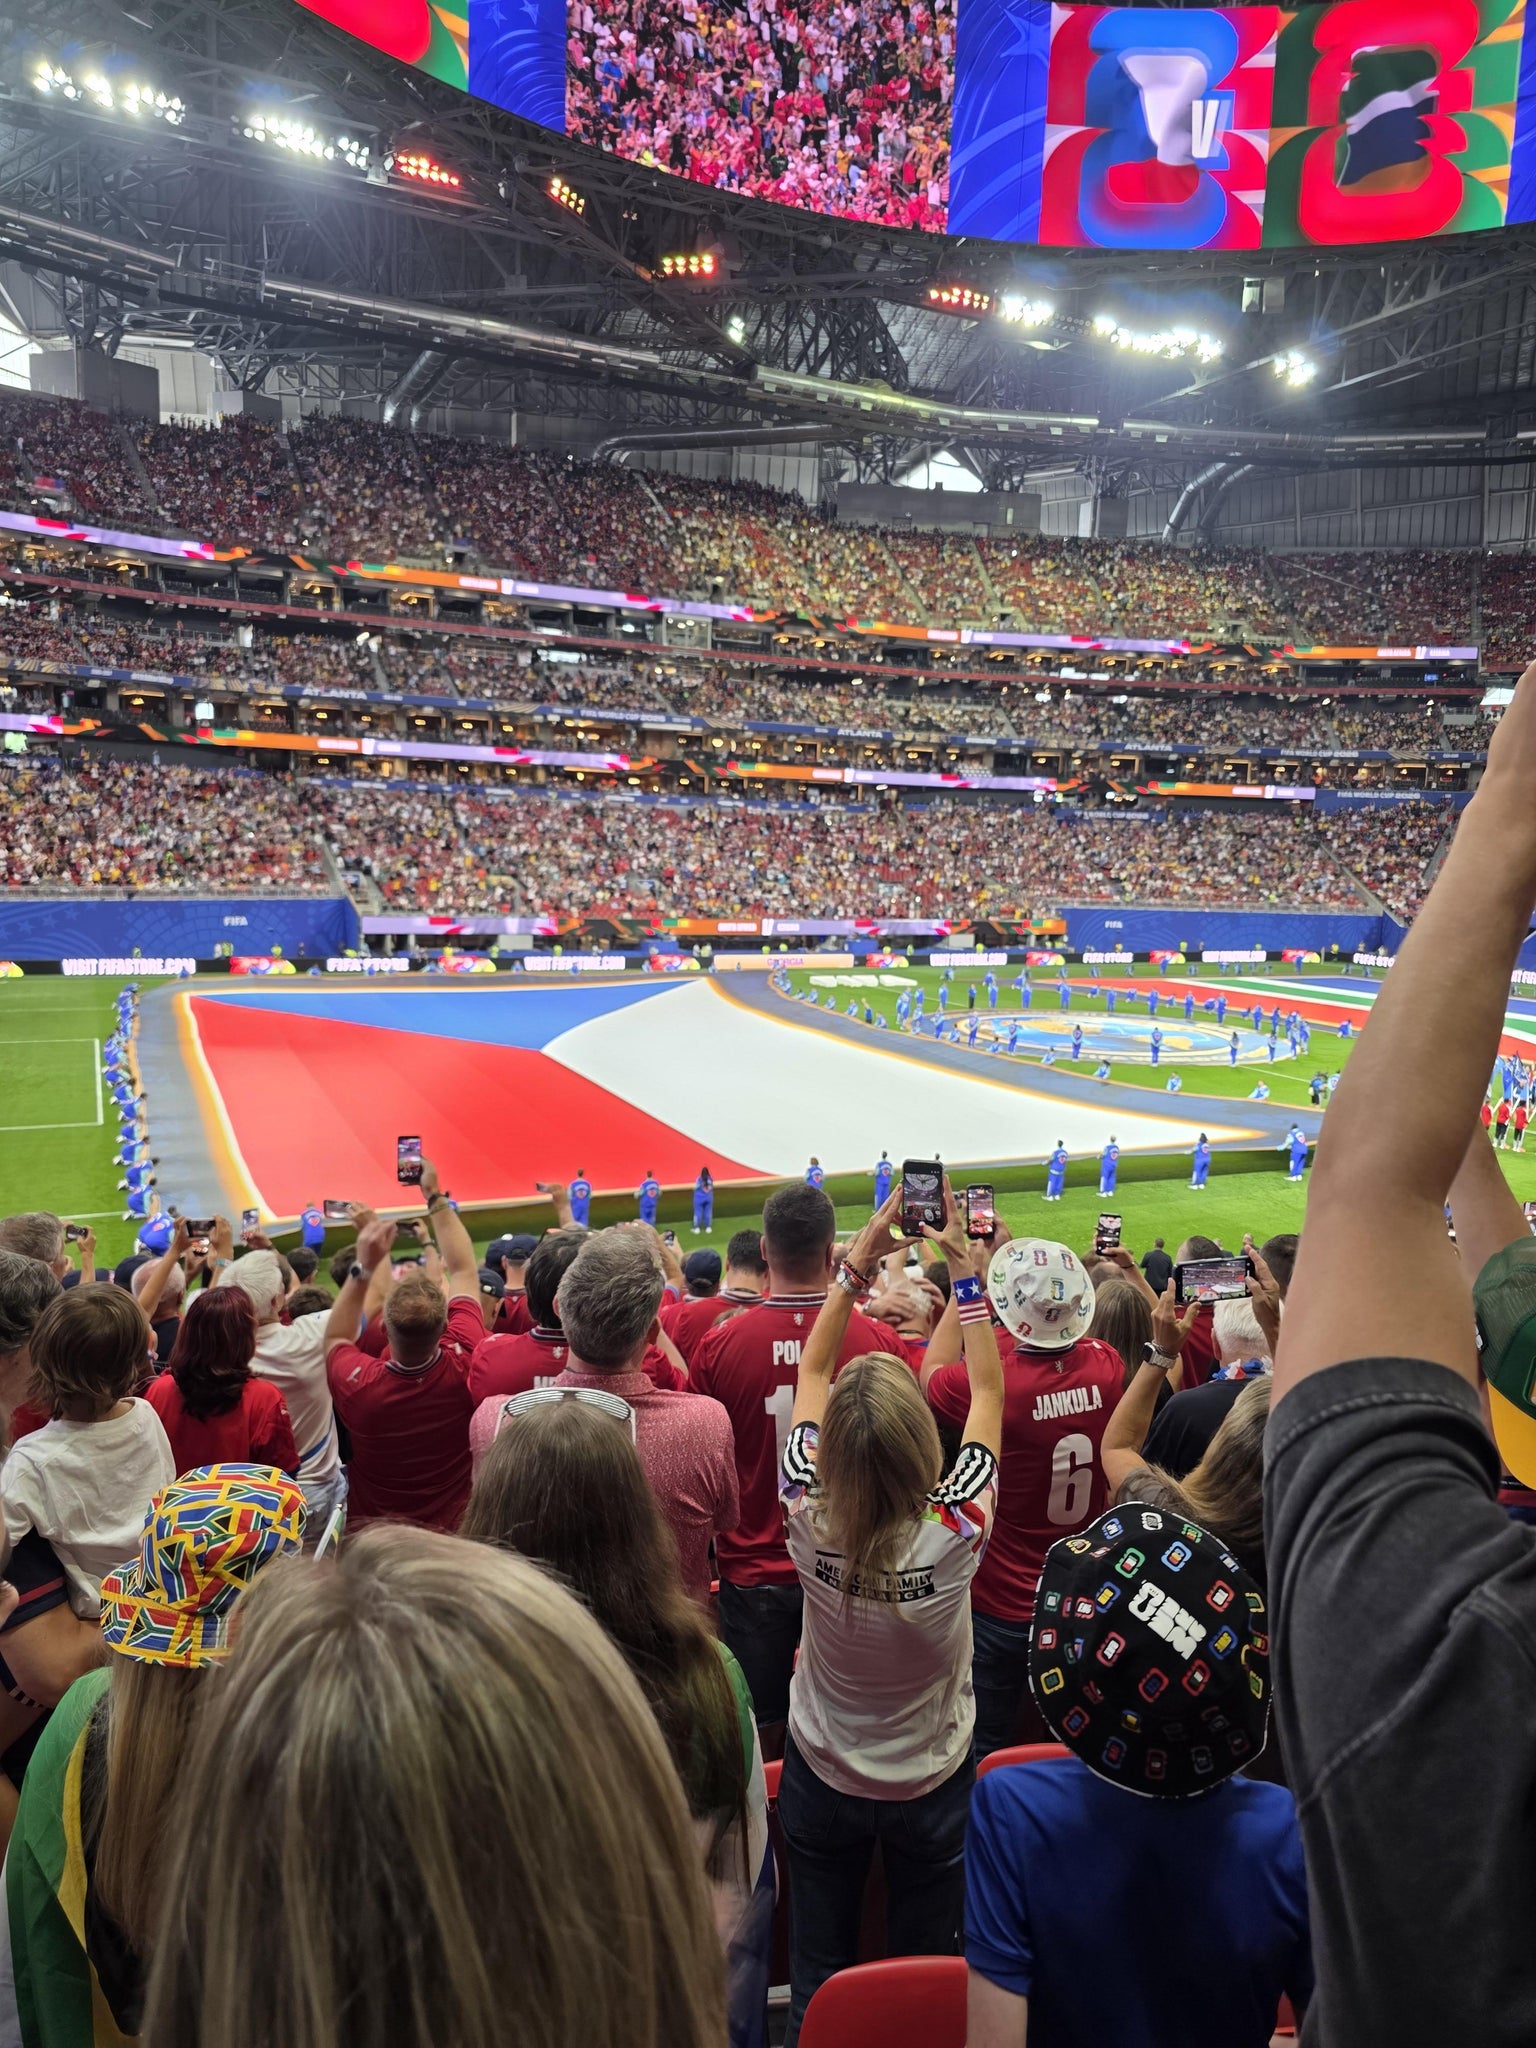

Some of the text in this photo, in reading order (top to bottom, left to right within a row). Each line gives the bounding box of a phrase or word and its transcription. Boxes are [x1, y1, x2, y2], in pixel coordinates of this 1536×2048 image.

[837, 728, 884, 738] ATLANTA
[1124, 743, 1173, 752] ATLANTA
[223, 915, 249, 927] FIFA
[1104, 920, 1124, 929] FIFA
[62, 958, 98, 975] VISIT
[327, 957, 361, 972] FIFA
[1353, 952, 1396, 968] FIFA STO
[1032, 1384, 1103, 1422] JANKULA
[1047, 1433, 1094, 1526] 6
